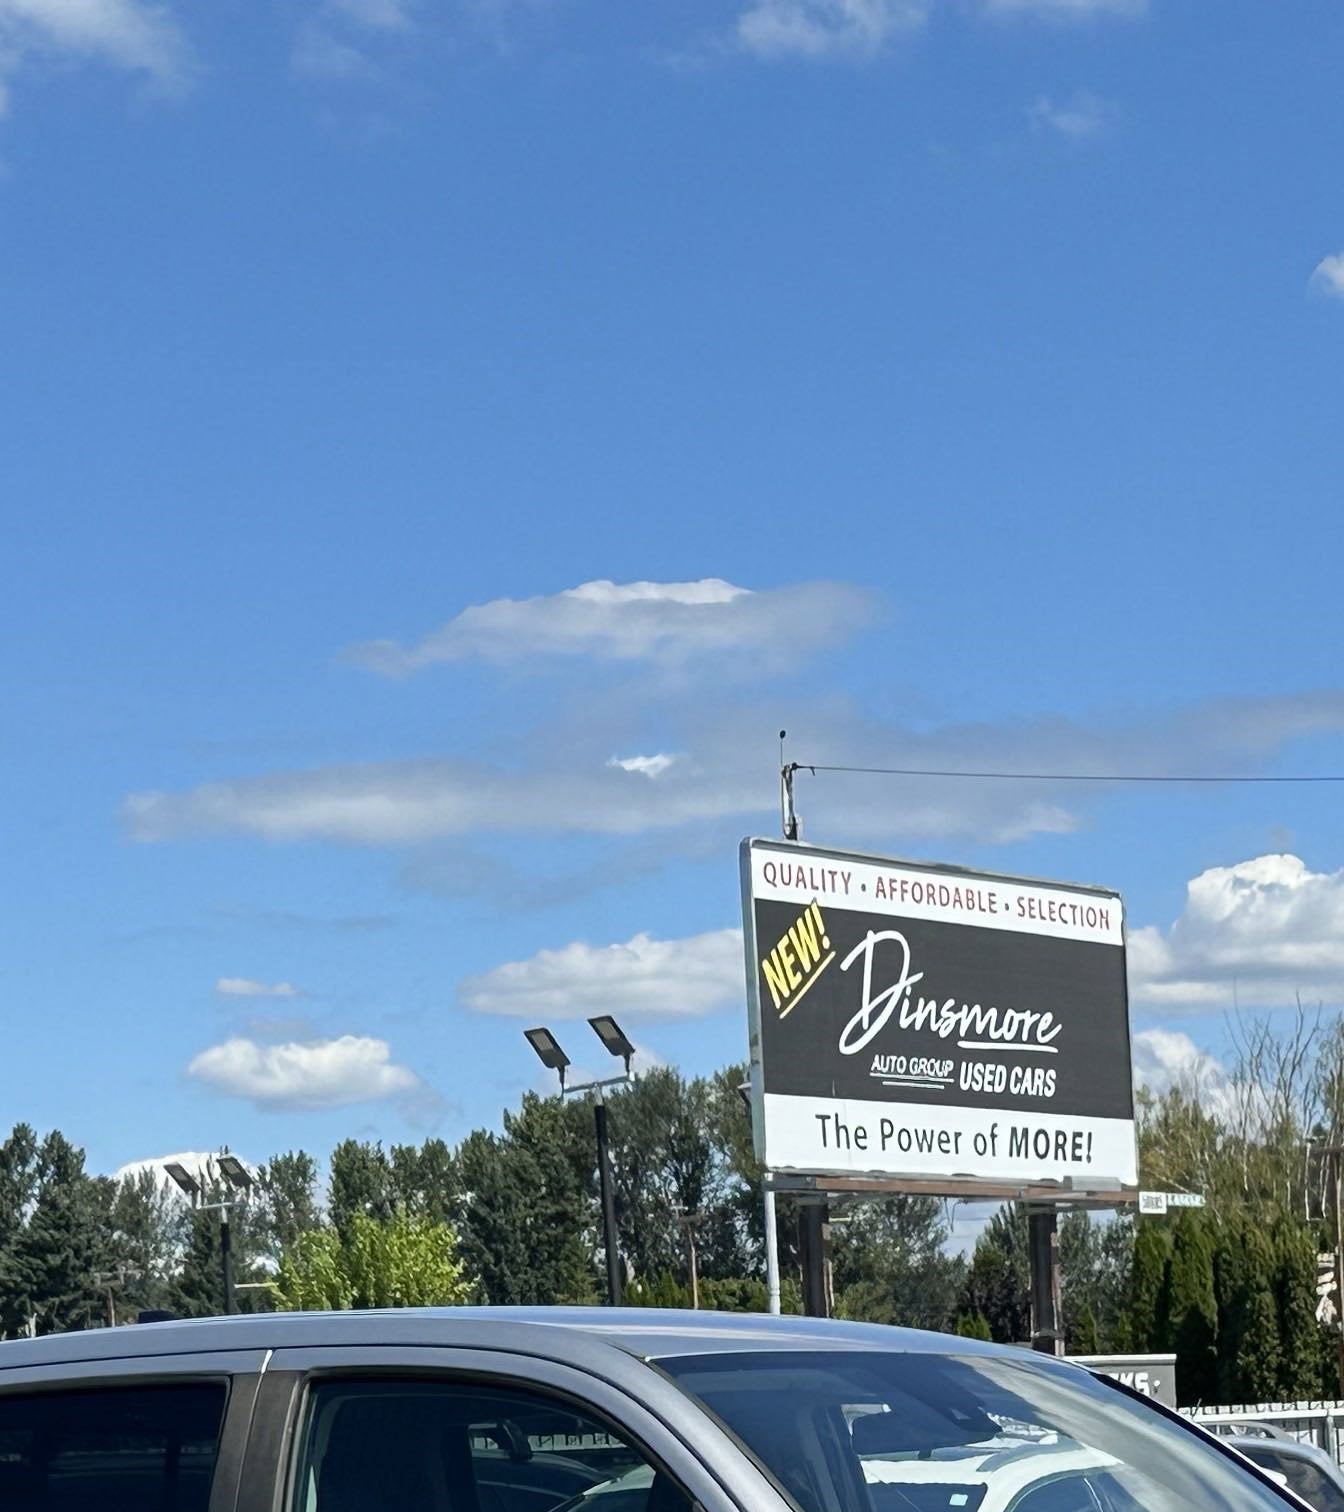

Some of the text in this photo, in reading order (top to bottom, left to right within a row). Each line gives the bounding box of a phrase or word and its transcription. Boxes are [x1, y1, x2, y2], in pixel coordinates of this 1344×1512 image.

[762, 861, 1111, 931] QUALITY AFFORDABLE SELECTION
[761, 904, 831, 1009] NEW!
[838, 929, 1063, 1056] Dinsmore
[870, 1054, 1057, 1098] AUTO GROUP USED CARS
[815, 1113, 1094, 1163] The Power of MORE!
